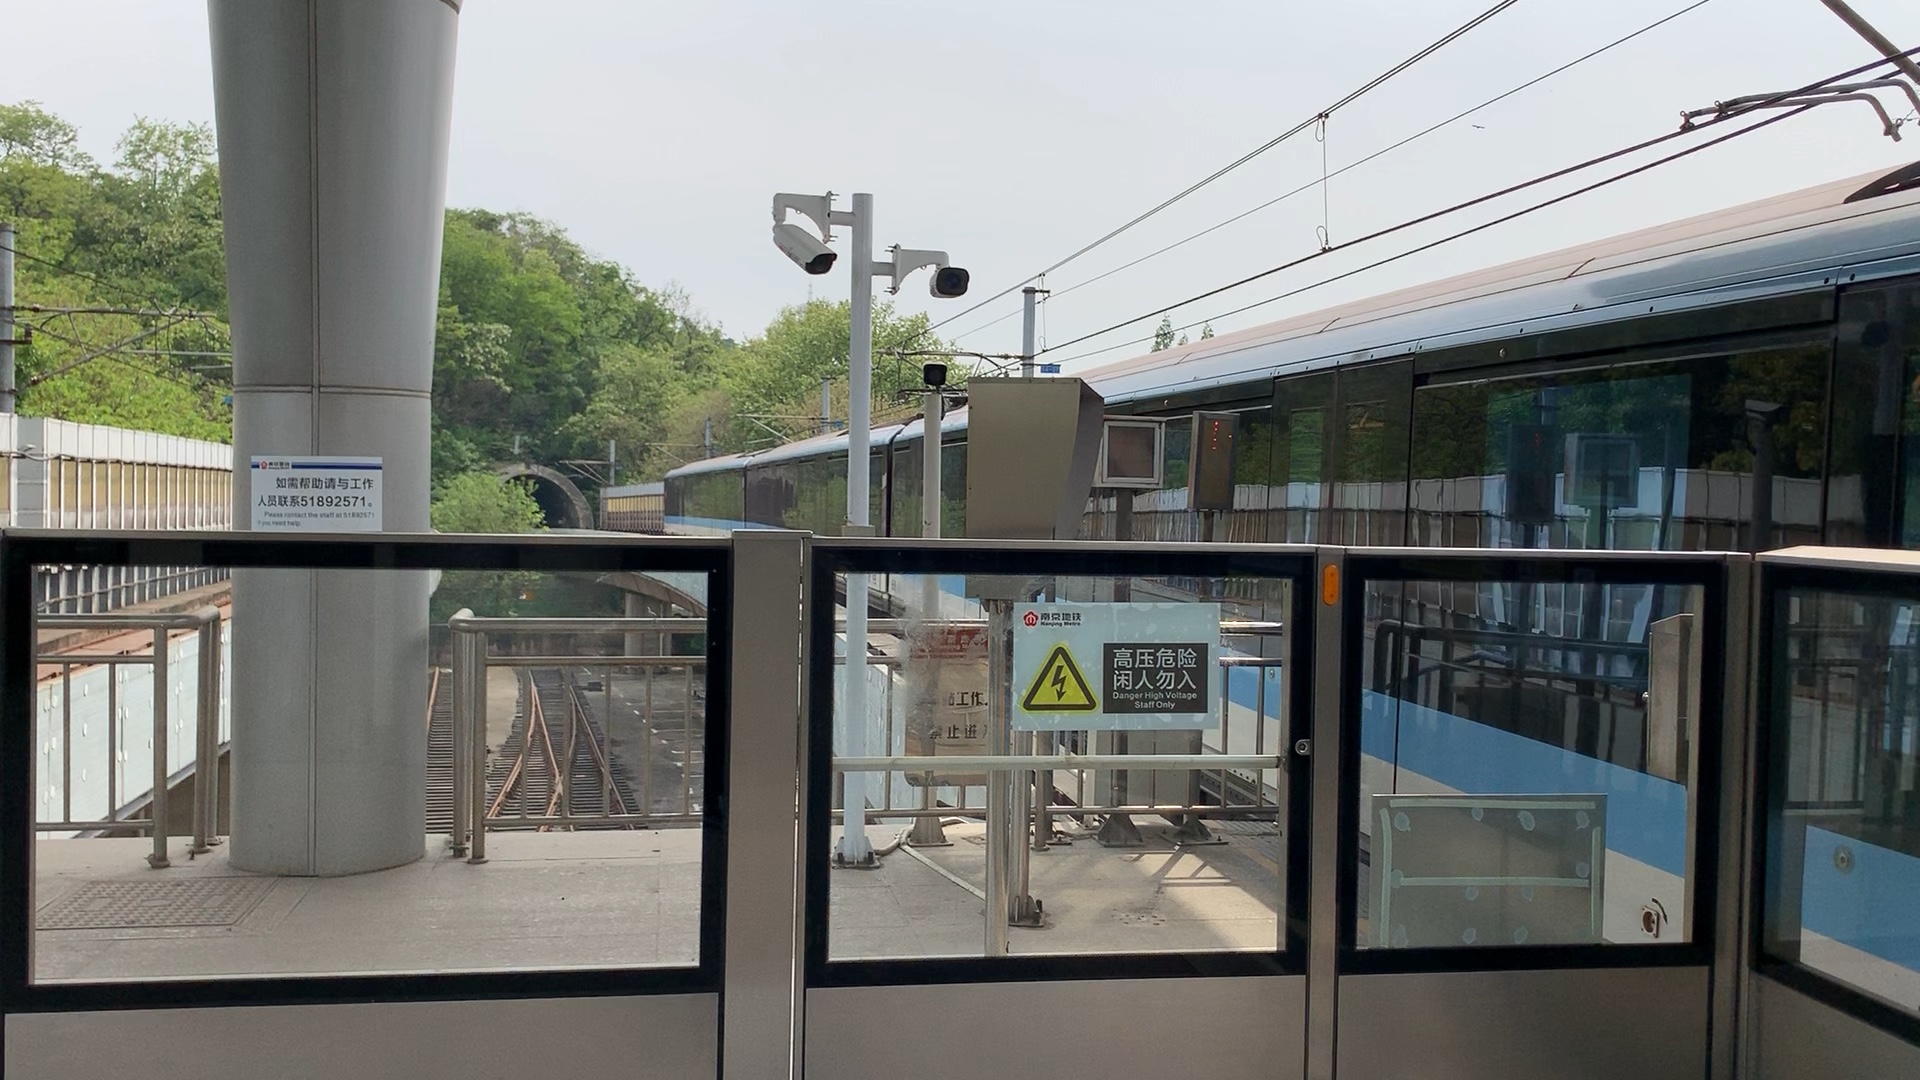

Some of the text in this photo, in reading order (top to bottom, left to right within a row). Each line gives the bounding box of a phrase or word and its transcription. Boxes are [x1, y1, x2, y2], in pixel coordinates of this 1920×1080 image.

[276, 476, 374, 490] 如需帮助请与工作
[258, 495, 373, 507] 人员联系51892571。
[1040, 612, 1082, 621] 南京地铁
[1112, 647, 1197, 668] 高压危险
[1112, 669, 1197, 690] 闲人勿入
[1112, 691, 1198, 700] Danger High Voltage
[1134, 701, 1176, 710] Staff Only
